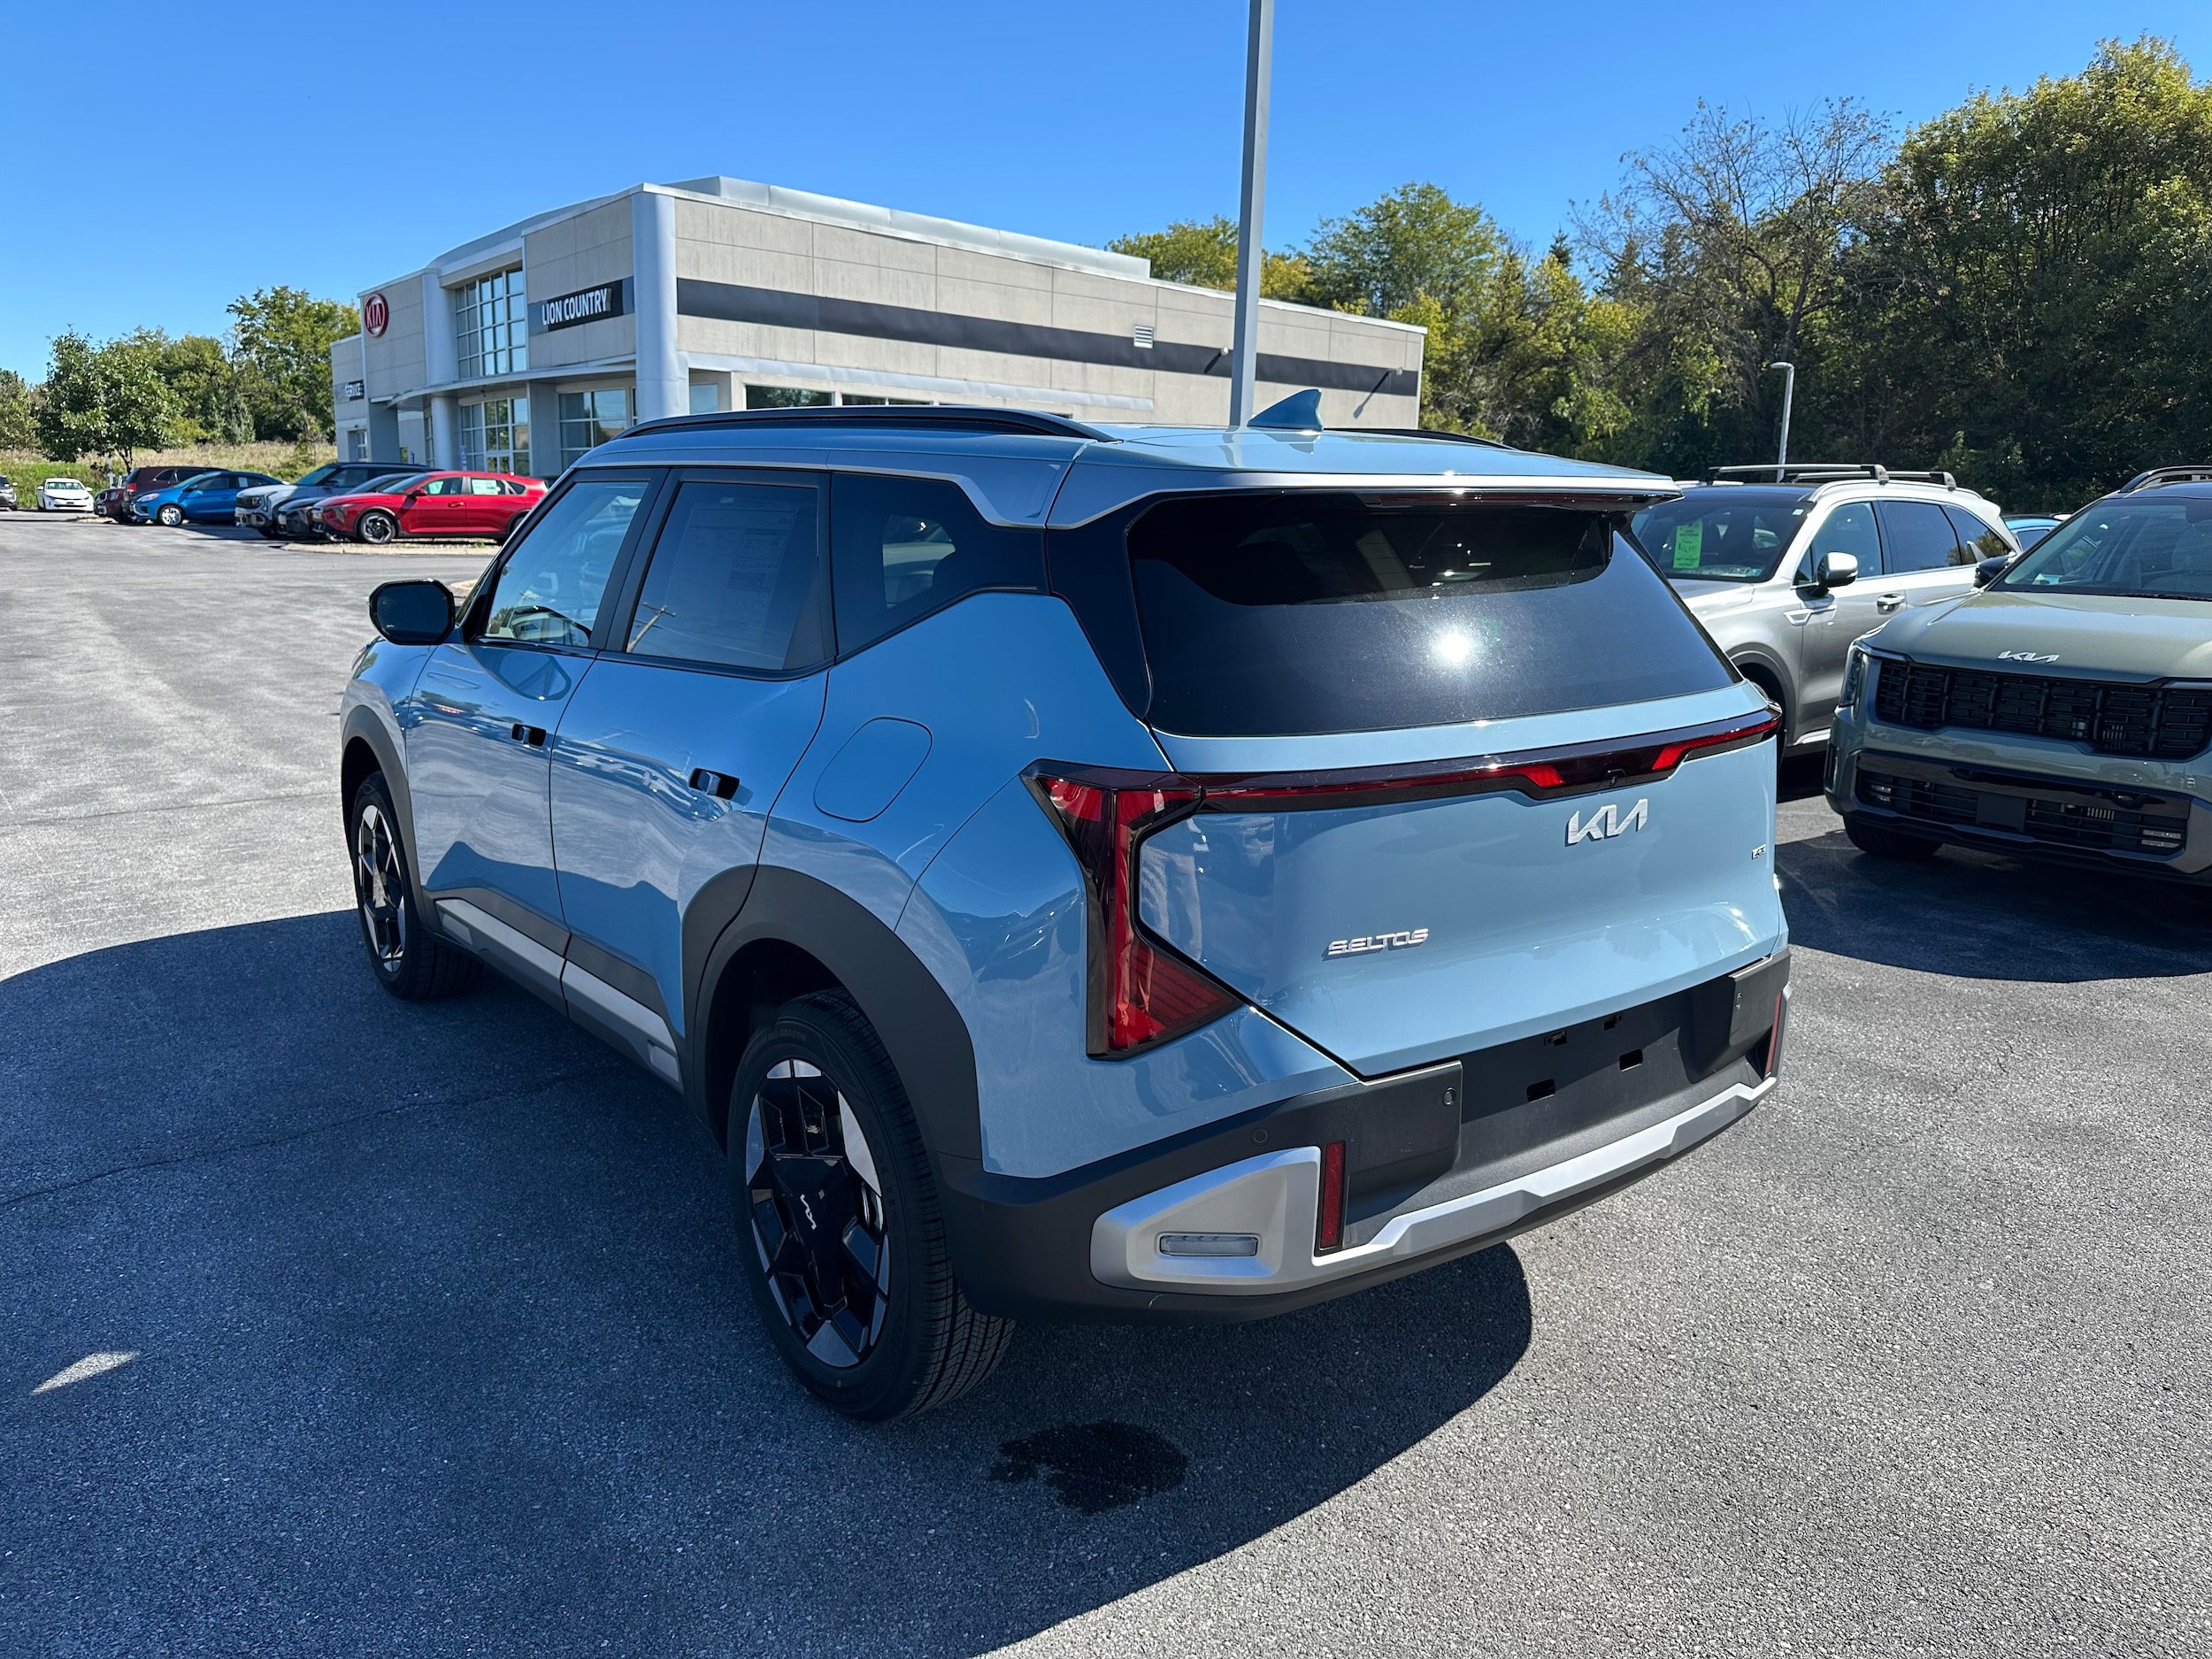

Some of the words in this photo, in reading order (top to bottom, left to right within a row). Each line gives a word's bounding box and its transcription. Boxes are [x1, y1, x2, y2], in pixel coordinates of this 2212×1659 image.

[365, 303, 382, 328] KIA
[541, 300, 563, 326] LION
[564, 288, 608, 321] COUNTRY
[1997, 649, 2060, 663] KIA
[1566, 798, 1648, 844] KIA
[1326, 927, 1429, 956] SELTOS
